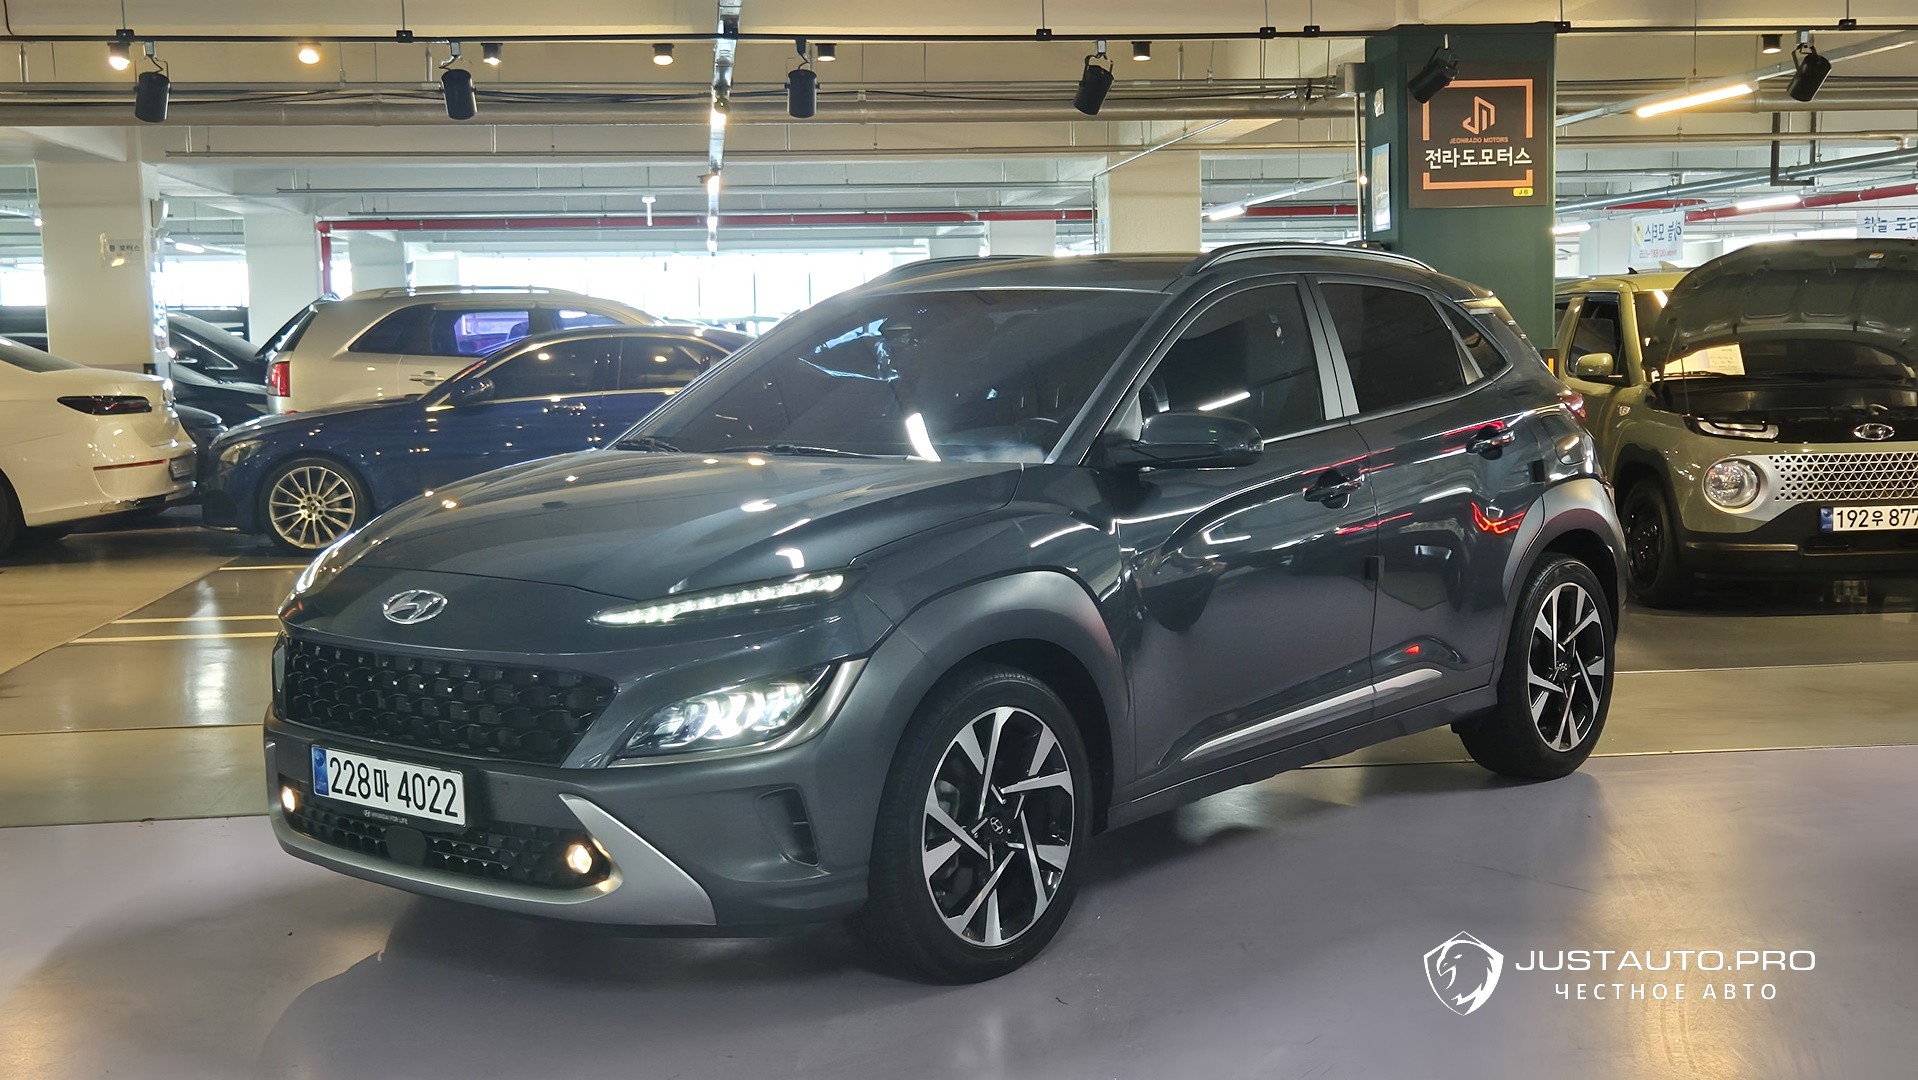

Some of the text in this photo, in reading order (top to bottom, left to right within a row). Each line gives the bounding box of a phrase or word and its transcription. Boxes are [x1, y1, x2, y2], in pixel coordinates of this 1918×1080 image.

[1483, 136, 1509, 144] MOTORS
[1425, 146, 1533, 170] 전라도모터스
[1864, 216, 1887, 233] 하늘
[1836, 509, 1884, 528] 192우
[329, 756, 459, 818] 228마 4022
